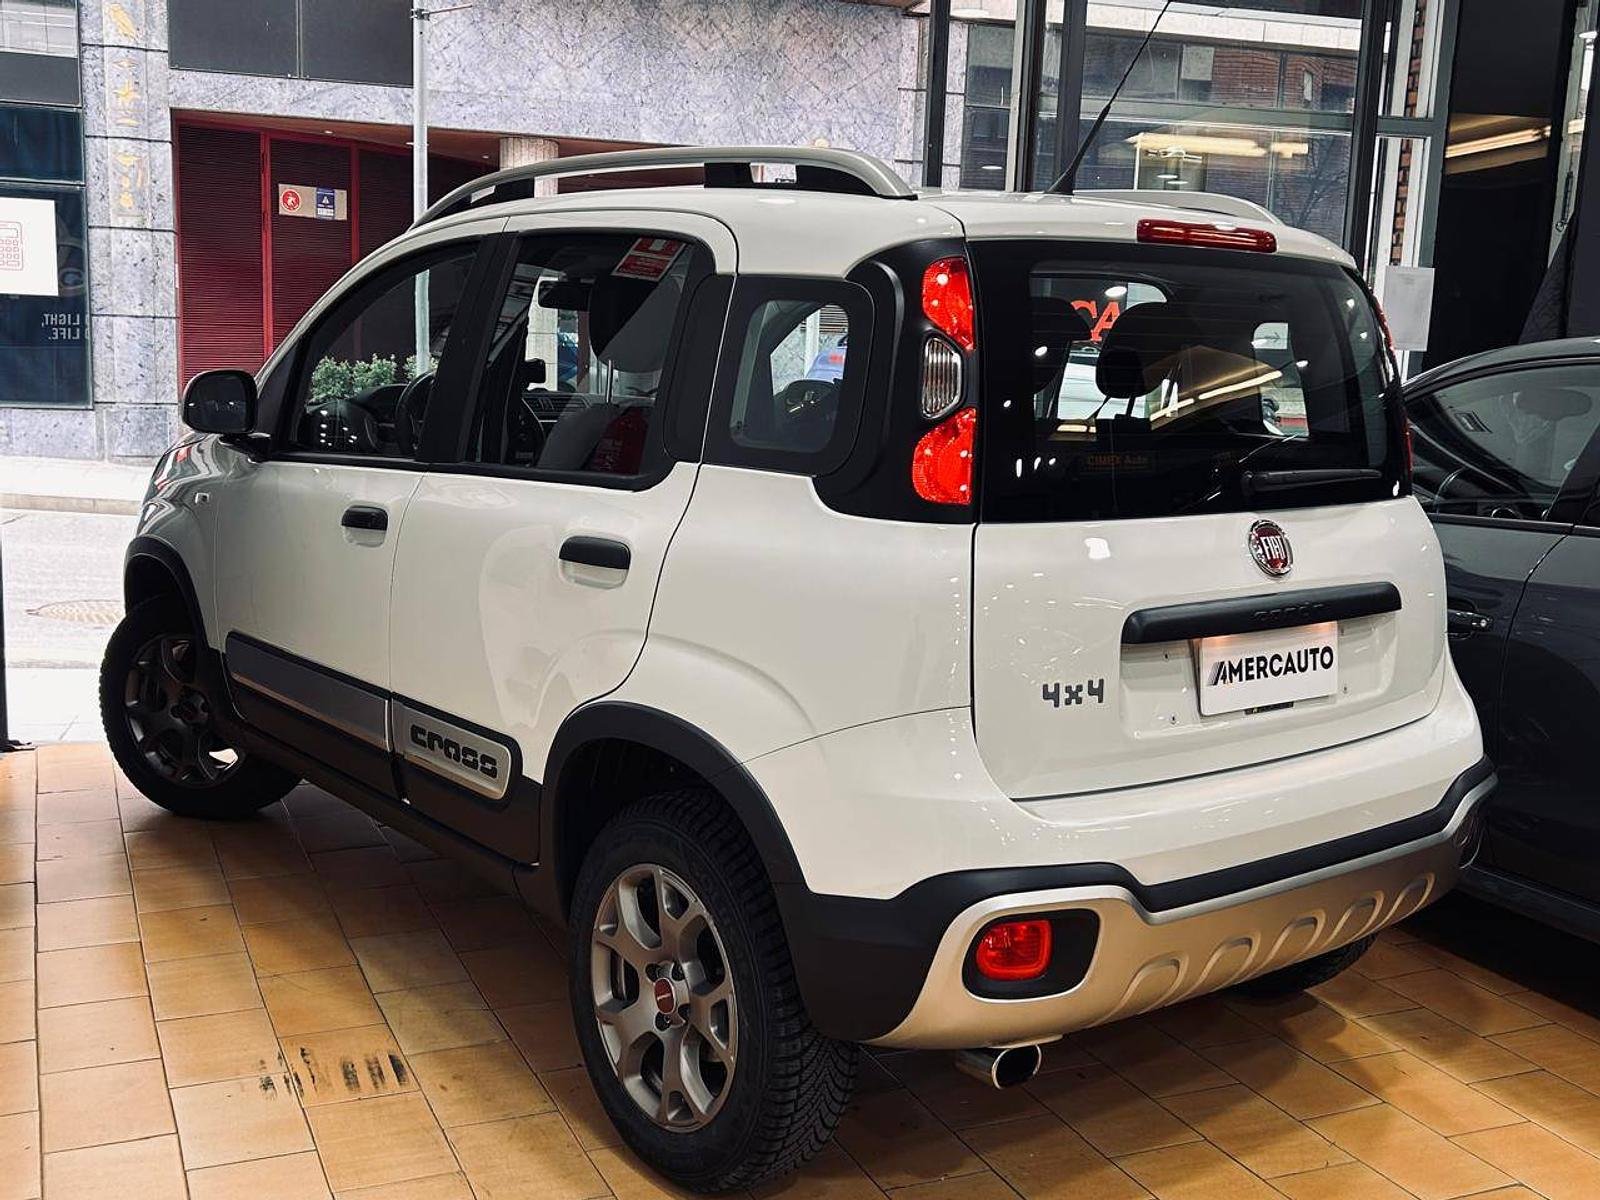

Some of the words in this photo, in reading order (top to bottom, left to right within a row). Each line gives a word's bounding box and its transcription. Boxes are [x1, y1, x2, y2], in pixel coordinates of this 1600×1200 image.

[1260, 535, 1287, 560] FIAT
[1208, 645, 1334, 686] AMERCAUTO
[1042, 678, 1104, 708] 4x4
